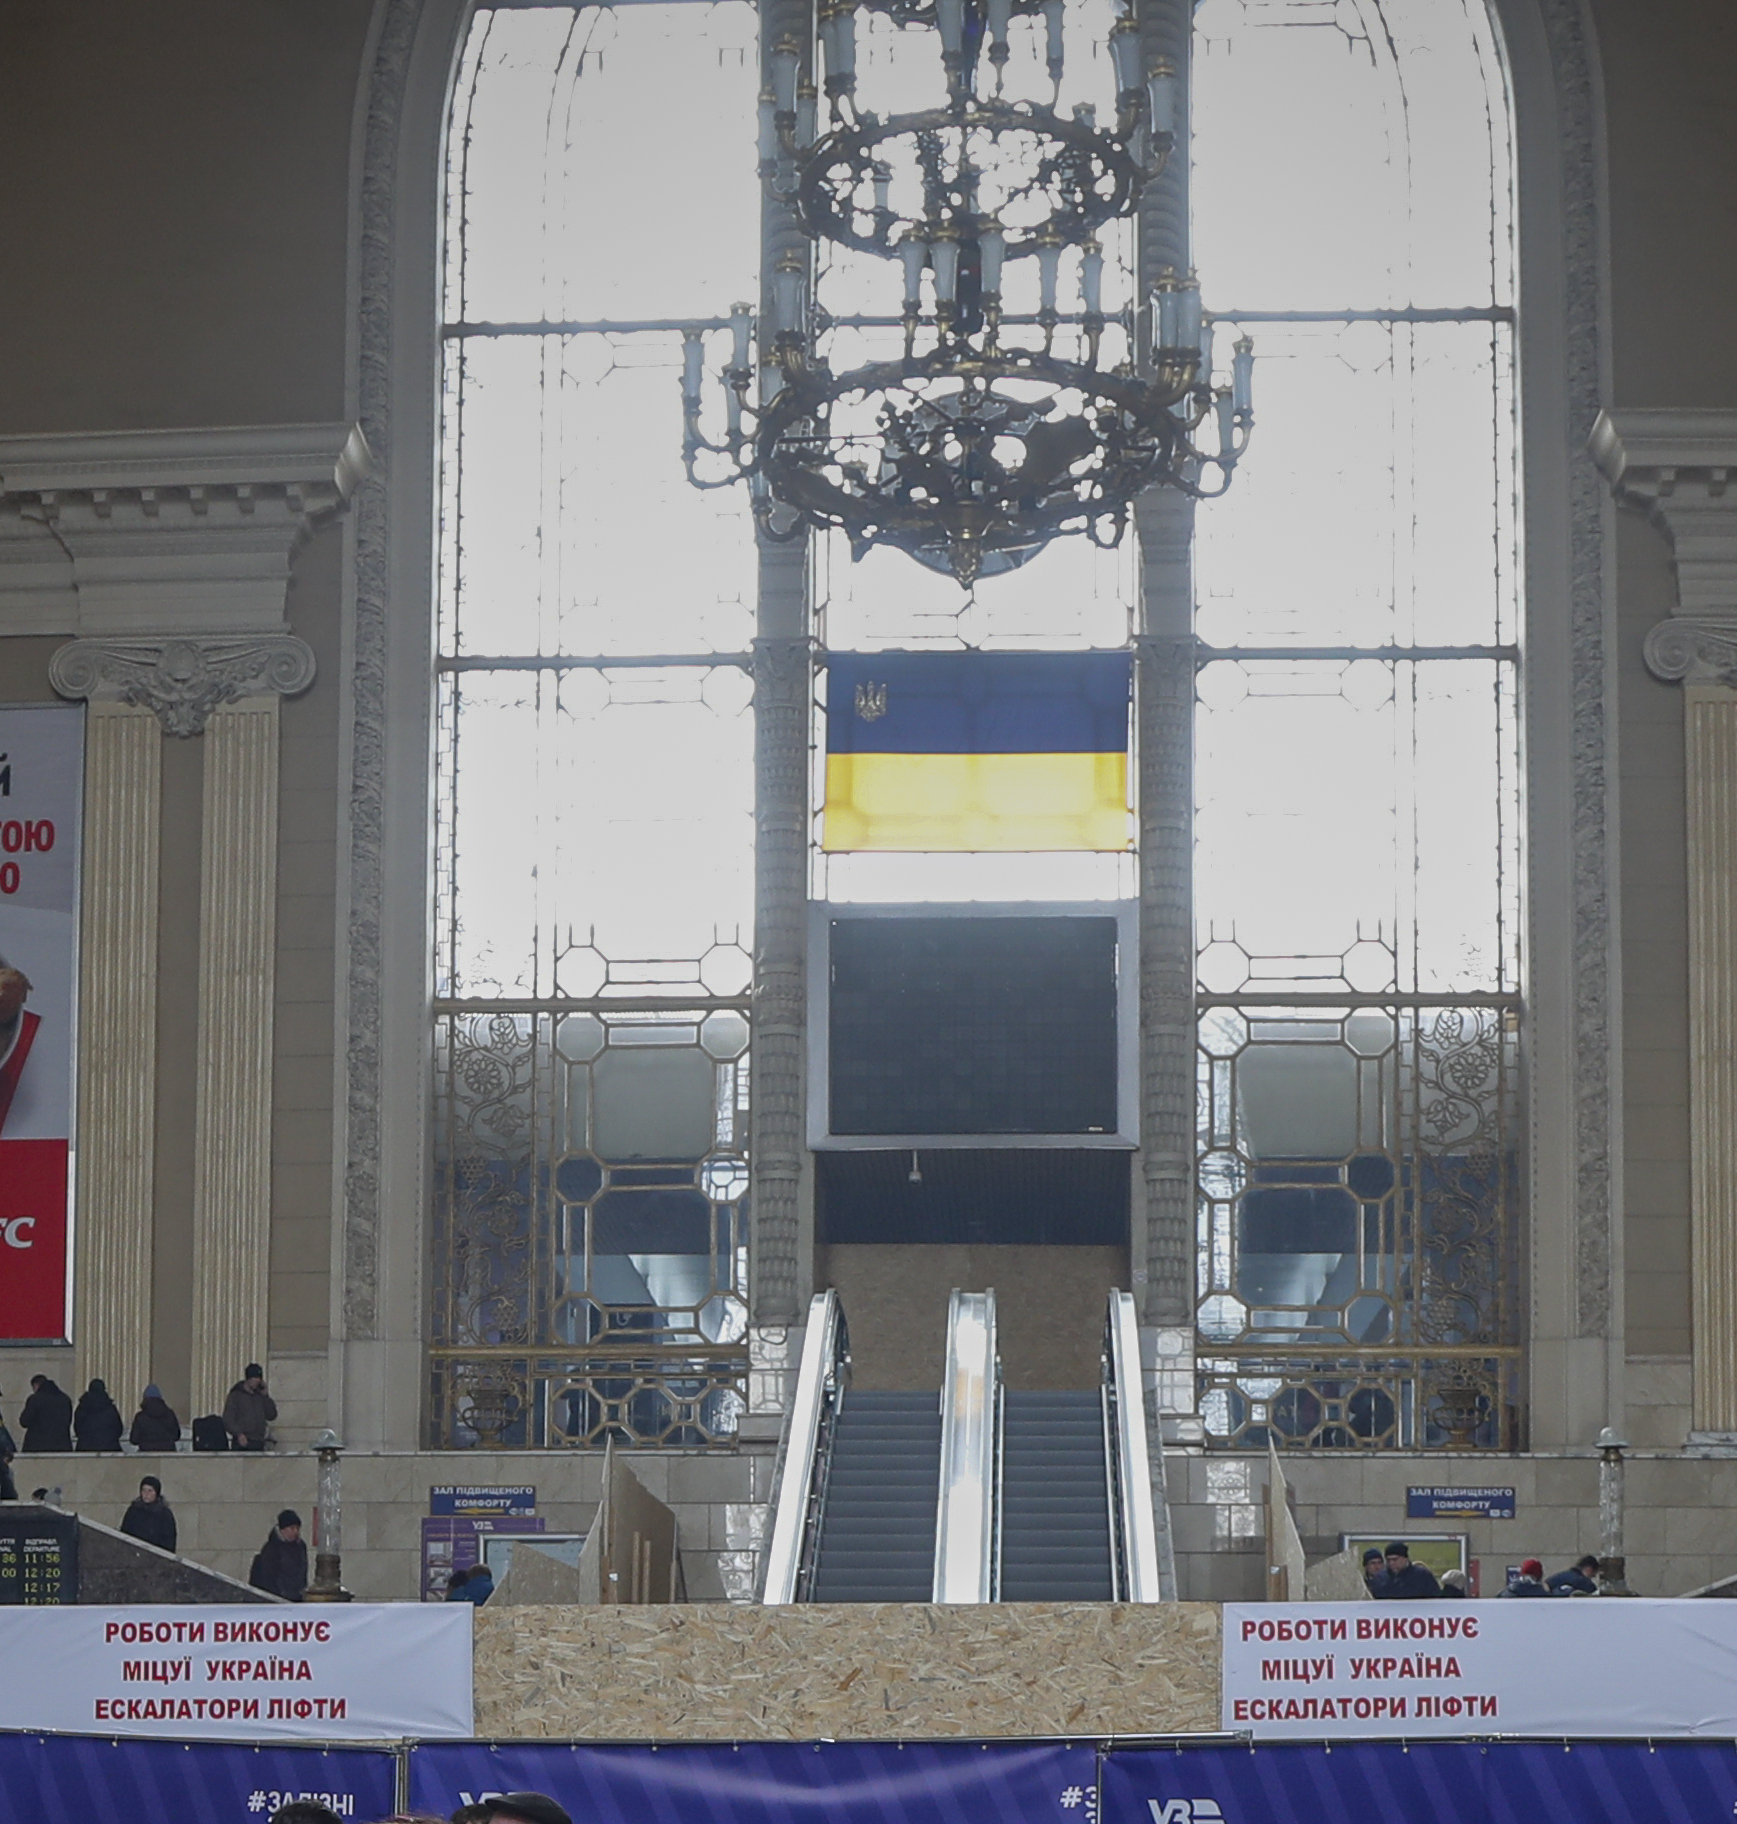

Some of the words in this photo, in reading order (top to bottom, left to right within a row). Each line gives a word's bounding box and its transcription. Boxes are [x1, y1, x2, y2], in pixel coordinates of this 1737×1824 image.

[433, 1487, 453, 1495] ЗАЛ
[456, 1487, 533, 1496] ПІДВИЩЕНОГО
[1410, 1488, 1431, 1496] ЗАЛ
[1433, 1488, 1513, 1497] ПІДВИЩЕНОГО
[454, 1499, 513, 1507] КОМФОРТУ
[1432, 1500, 1490, 1509] КОМФОРТУ
[24, 1568, 61, 1578] 12:20
[24, 1583, 61, 1593] 12:17
[105, 1621, 205, 1644] РОБОТИ
[213, 1620, 331, 1643] ВИКОНУЄ
[1241, 1618, 1348, 1642] РОБОТИ
[1356, 1617, 1480, 1641] ВИКОНУЄ
[122, 1655, 191, 1686] МІЦУЇ
[206, 1656, 312, 1683] УКРАЇНА
[1262, 1653, 1335, 1682] МІЦУЇ
[1350, 1652, 1462, 1681] УКРАЇНА
[95, 1698, 260, 1720] ЕСКАЛАТОРИ
[266, 1697, 347, 1720] ЛІФТИ
[1233, 1698, 1407, 1721] ЕСКАЛАТОРИ
[1415, 1695, 1498, 1719] ЛІФТИ
